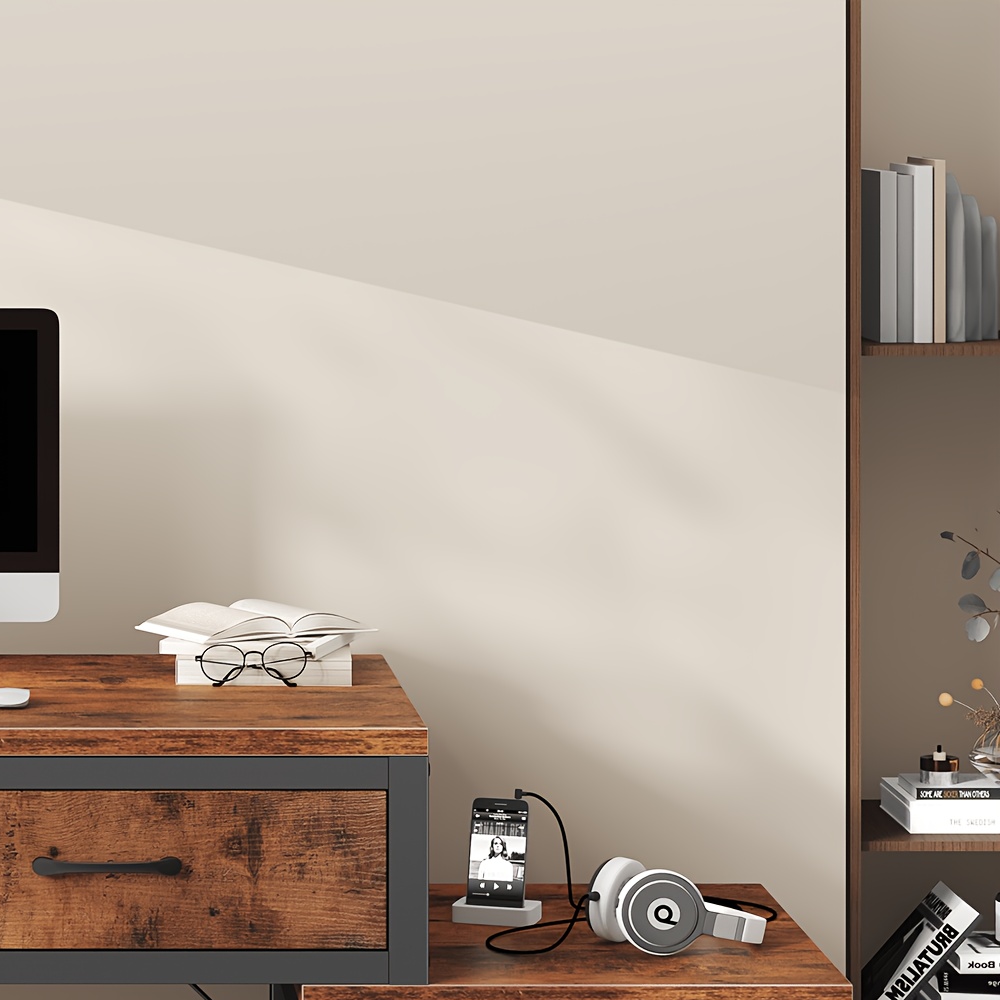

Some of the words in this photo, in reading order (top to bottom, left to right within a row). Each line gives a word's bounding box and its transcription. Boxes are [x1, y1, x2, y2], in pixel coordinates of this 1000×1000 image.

[919, 790, 933, 798] SOME
[933, 790, 943, 798] ARE
[959, 790, 972, 798] THAN
[972, 790, 990, 798] OTHERS
[949, 818, 961, 826] THE
[966, 818, 996, 826] SWEDISH
